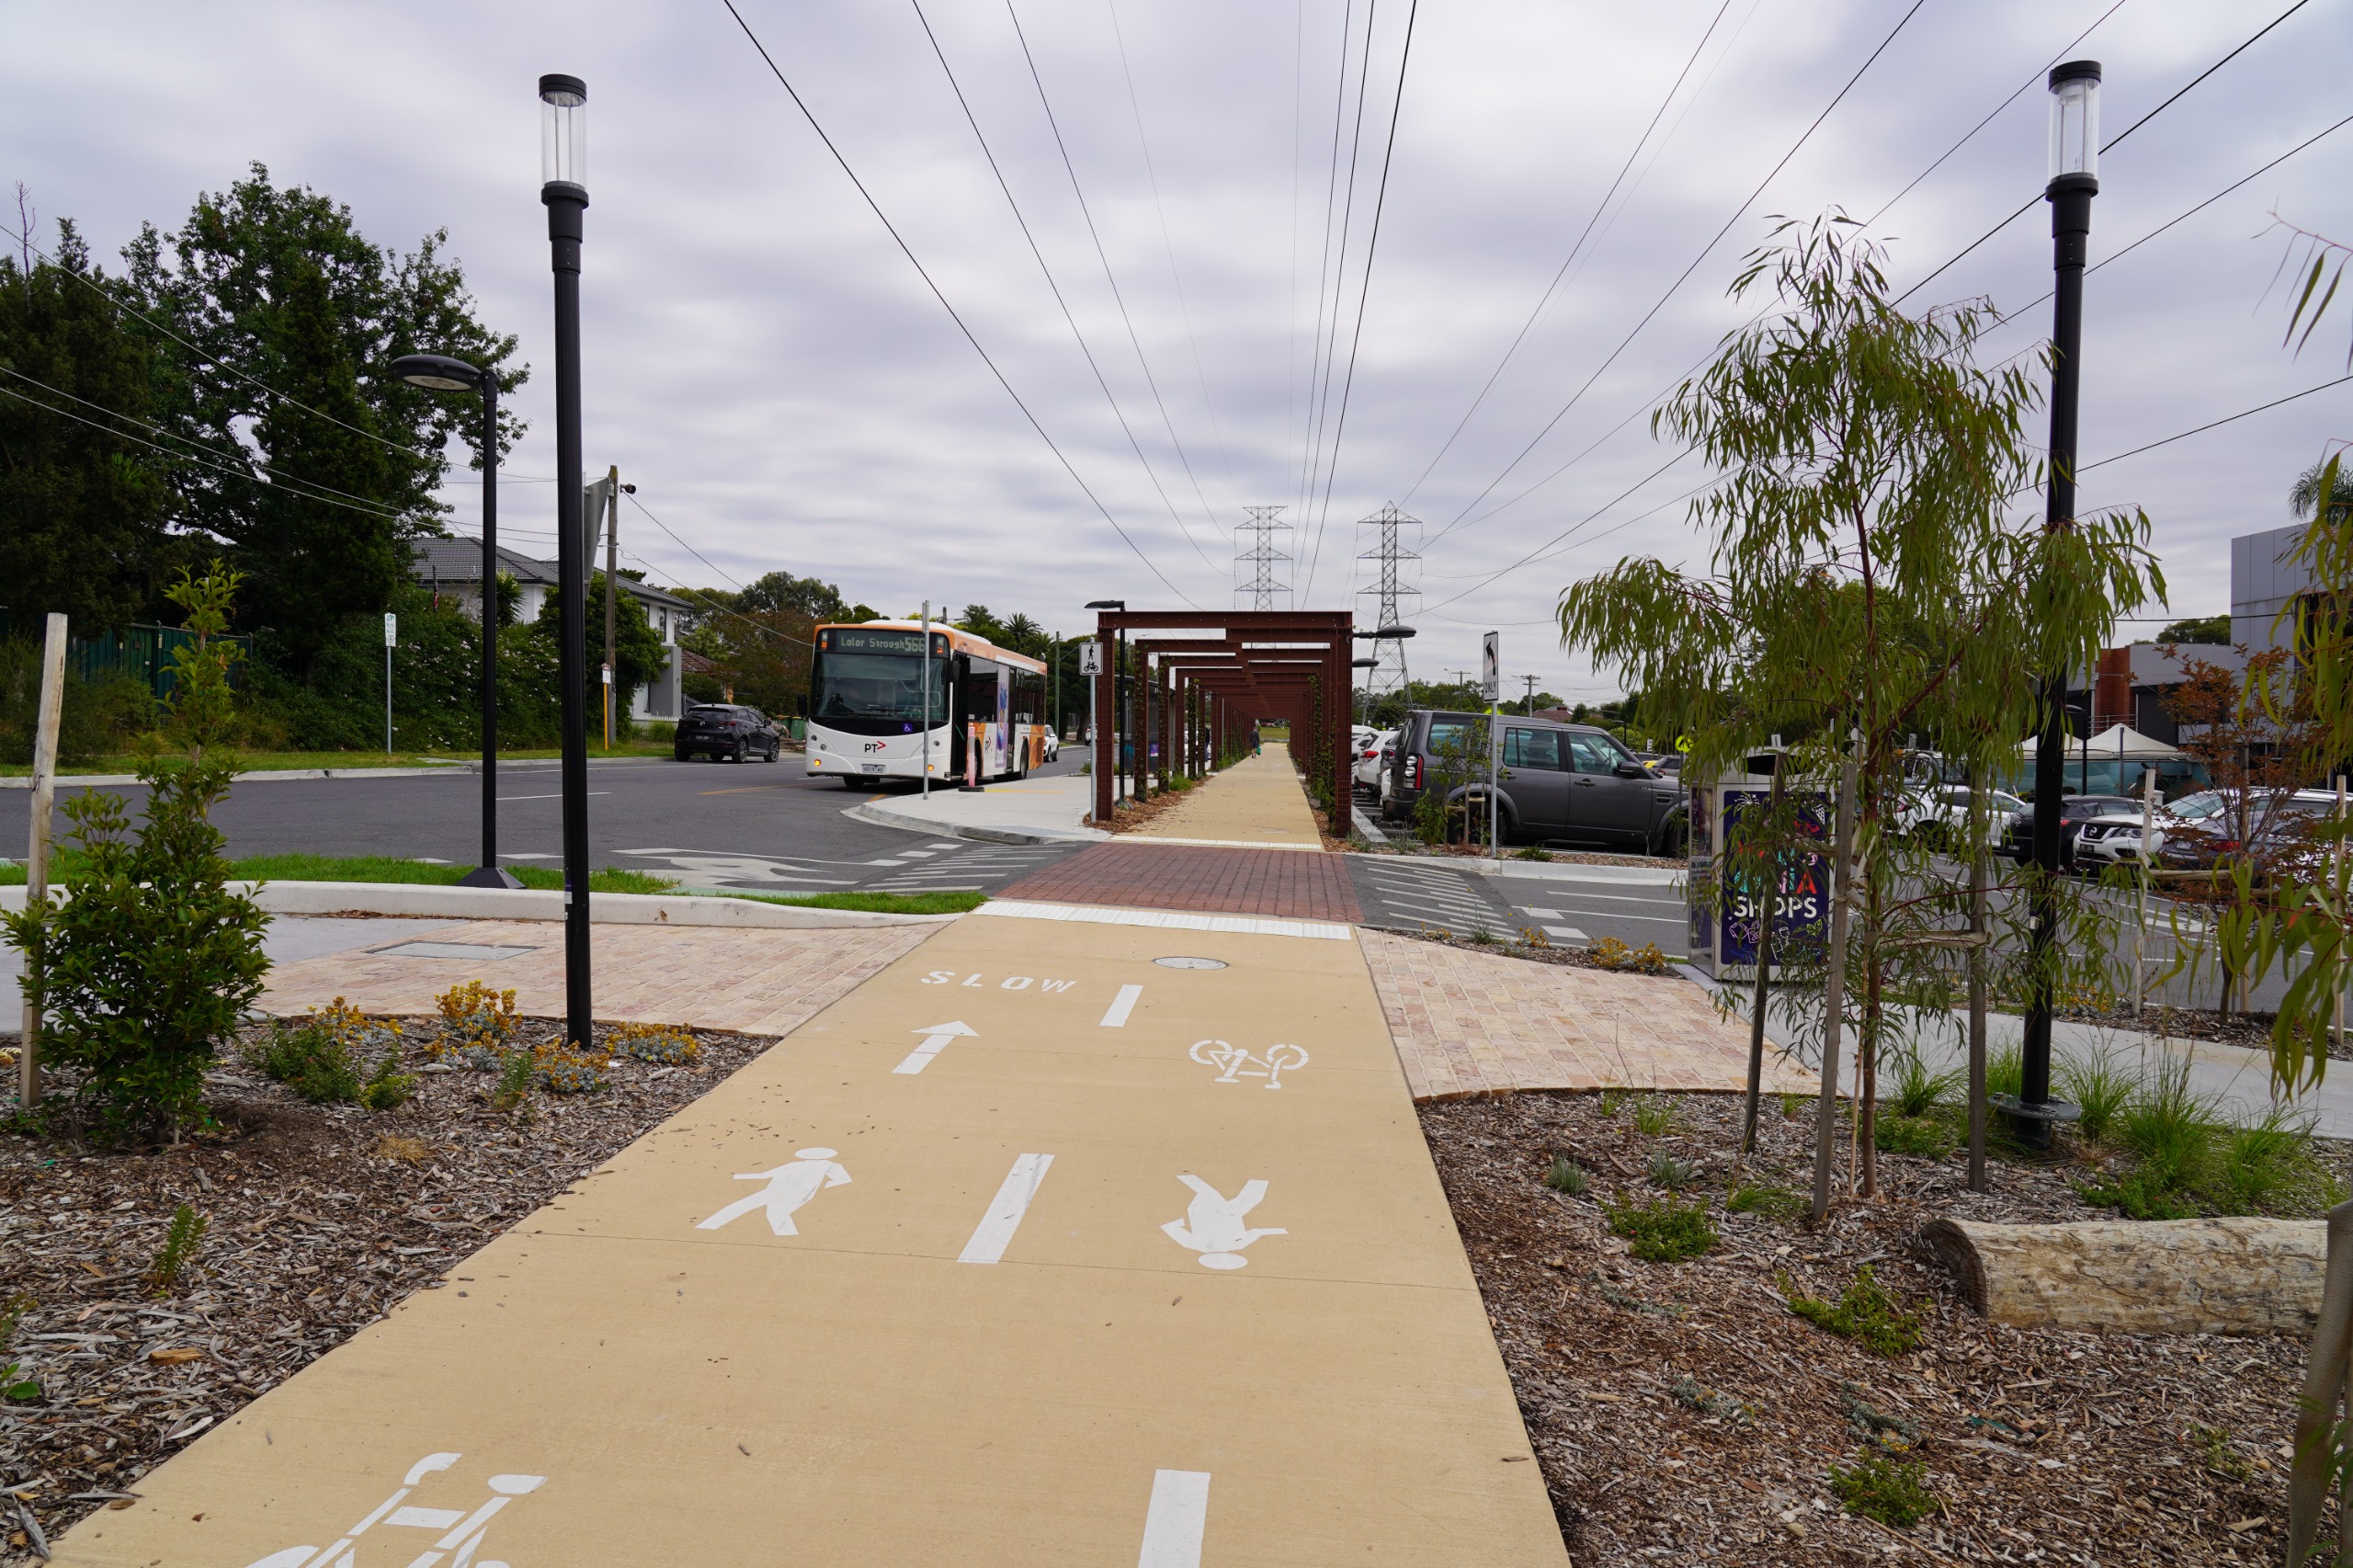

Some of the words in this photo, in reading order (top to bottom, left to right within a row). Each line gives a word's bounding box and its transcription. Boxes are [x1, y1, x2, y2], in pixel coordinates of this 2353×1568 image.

[841, 636, 865, 647] Lalor
[1484, 681, 1496, 693] ONLY
[920, 971, 1077, 993] SLOW
